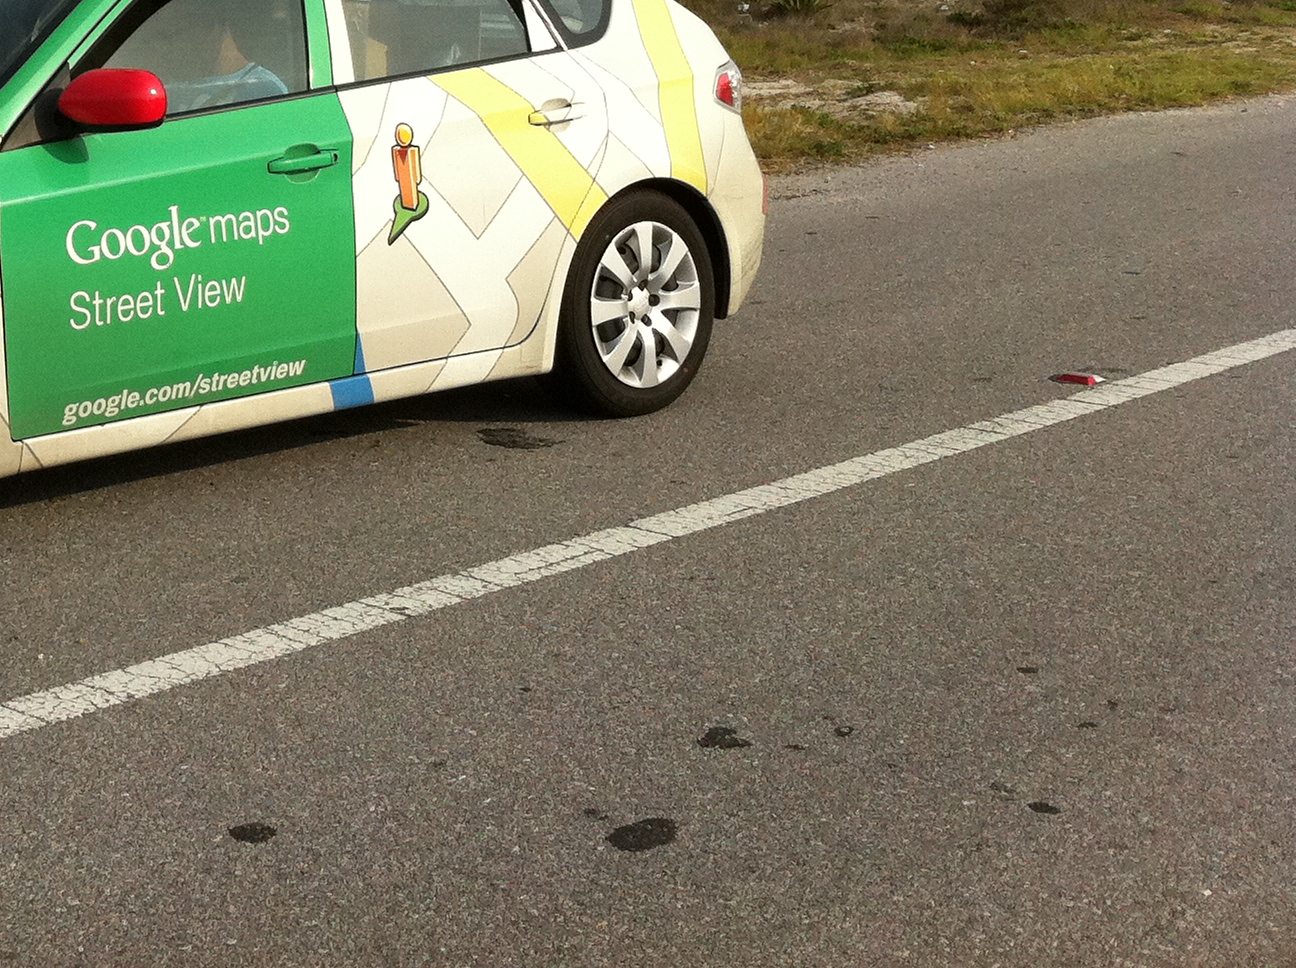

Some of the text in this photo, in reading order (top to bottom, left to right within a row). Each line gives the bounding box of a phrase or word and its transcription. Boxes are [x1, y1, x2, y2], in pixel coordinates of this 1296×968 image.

[65, 204, 290, 271] Google maps
[69, 274, 246, 331] Street View
[62, 360, 306, 425] google.com/streetview
